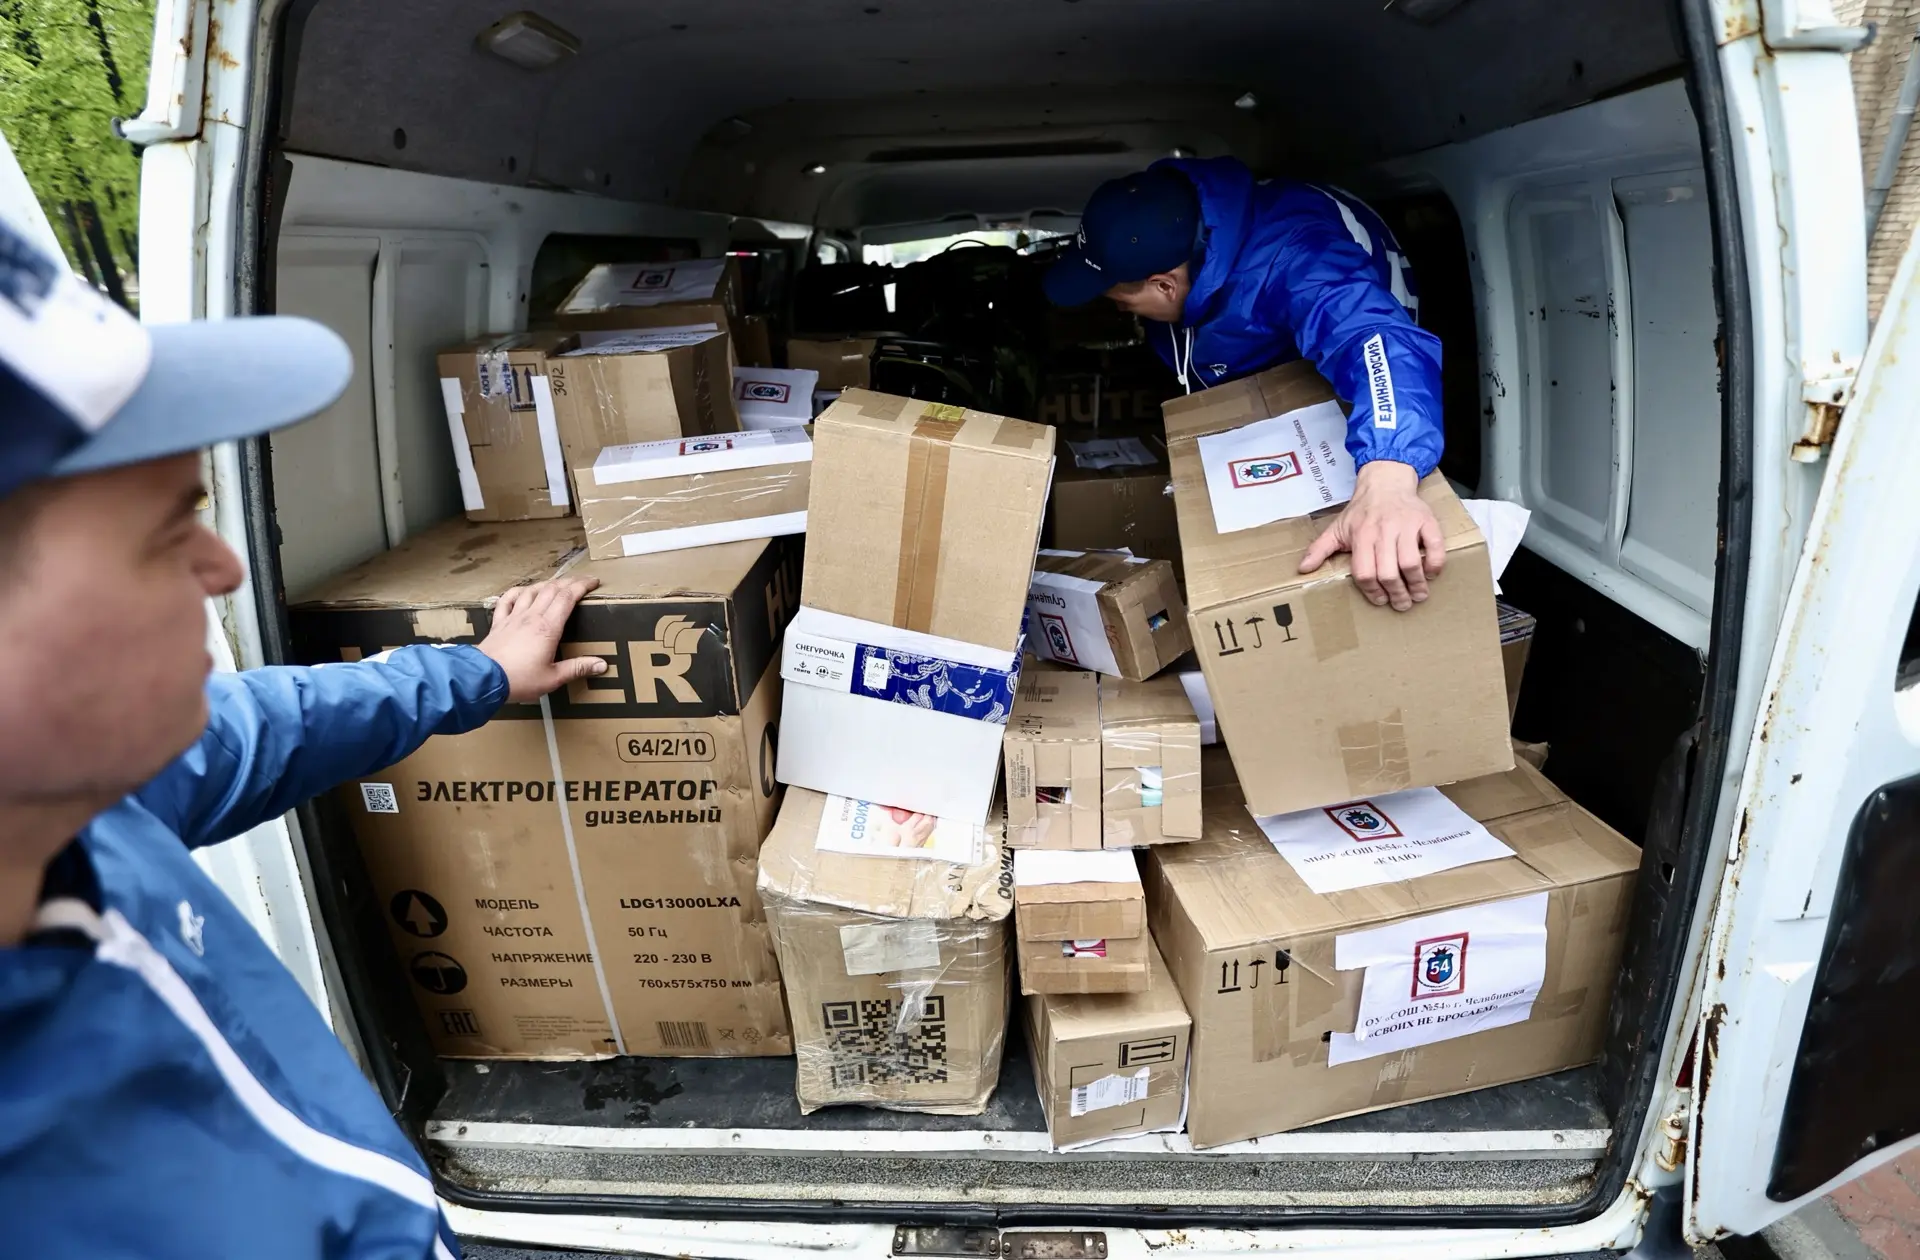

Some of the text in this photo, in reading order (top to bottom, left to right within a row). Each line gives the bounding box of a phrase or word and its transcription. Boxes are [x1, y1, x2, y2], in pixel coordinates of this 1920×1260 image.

[552, 362, 567, 396] 3012
[1374, 375, 1393, 422] ЕДИНАЯ
[1257, 465, 1274, 477] 54
[795, 643, 845, 659] СНЕГУРОЧКА
[627, 737, 708, 758] 64/2/10
[416, 780, 718, 802] ЭЛЕКТРОГЕНЕРАТОР
[585, 806, 722, 828] дизельный
[1353, 815, 1374, 826] 54
[1413, 830, 1472, 847] Челябинска
[475, 899, 539, 911] МОДЕЛЬ
[620, 897, 742, 909] LDG13000LXA
[483, 926, 553, 937] ЧАСТОТА
[628, 927, 668, 938] 50 Гц
[492, 953, 594, 963] НАПРЯЖЕНИЕ
[633, 953, 659, 964] 220
[672, 953, 697, 964] 230
[1429, 958, 1450, 976] 54
[500, 978, 573, 988] РАЗМЕРЫ
[731, 980, 752, 988] мм
[1465, 988, 1525, 1006] Челябинска
[1368, 1004, 1499, 1038] «СВОИХ НЕ БРОСАЕМ»
